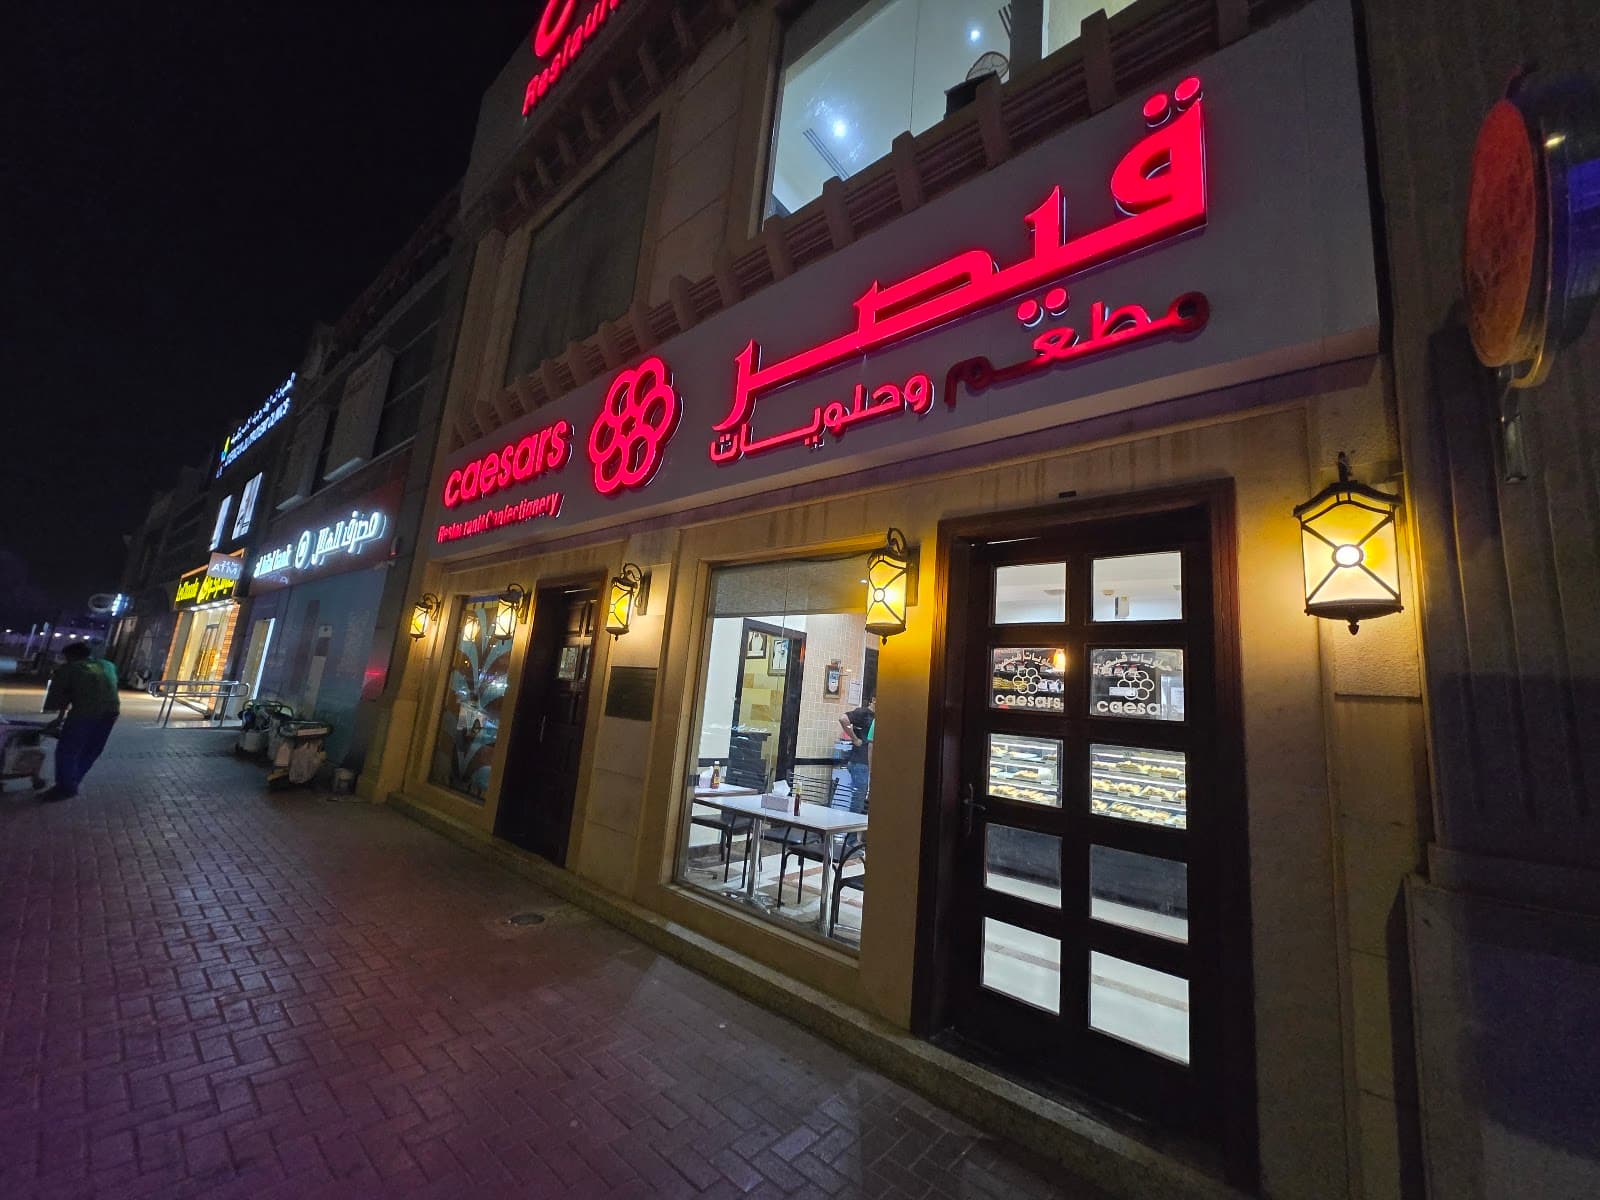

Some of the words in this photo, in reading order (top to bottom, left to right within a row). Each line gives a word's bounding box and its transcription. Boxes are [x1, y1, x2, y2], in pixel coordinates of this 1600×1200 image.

[522, 0, 619, 116] Restaur
[711, 76, 1208, 432] قيصر
[945, 291, 1210, 406] مطعم
[709, 373, 933, 462] وحلويات
[443, 420, 570, 508] caesars
[486, 491, 560, 529] Confectionery
[211, 563, 238, 575] ATM
[995, 695, 1061, 709] caesars
